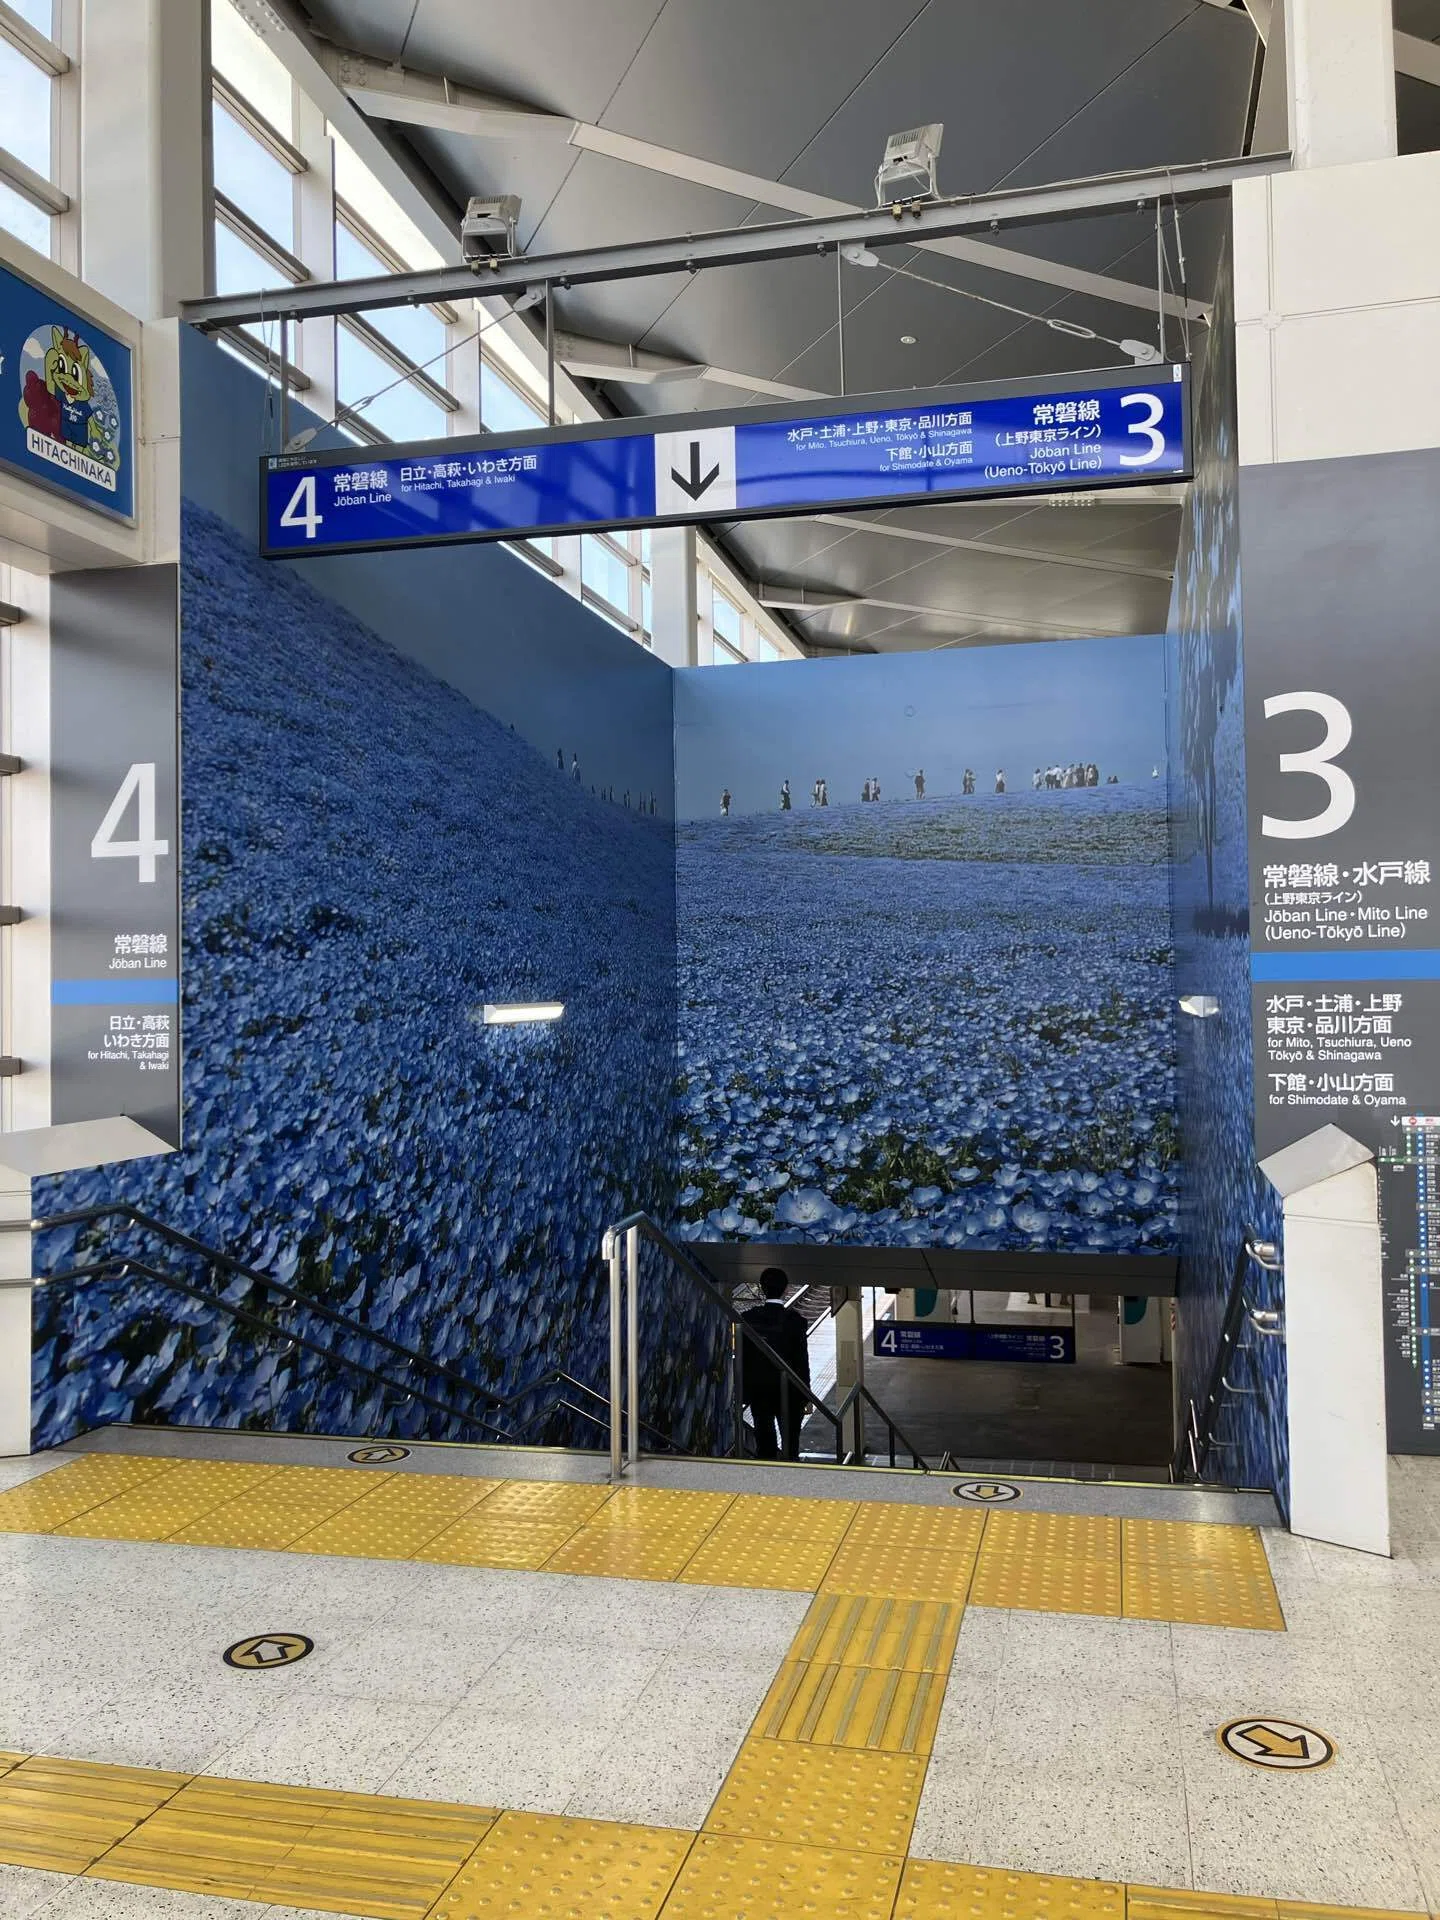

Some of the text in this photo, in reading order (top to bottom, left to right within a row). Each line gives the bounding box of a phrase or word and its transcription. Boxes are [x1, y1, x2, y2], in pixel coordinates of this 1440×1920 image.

[1032, 399, 1100, 426] 常磐線
[796, 443, 807, 451] for
[920, 431, 926, 439] &
[928, 428, 973, 439] Shinagawa
[1119, 393, 1166, 467] 3
[31, 433, 113, 487] HITACHINAKA
[884, 440, 973, 462] 下館・小山方面
[1030, 443, 1101, 460] Jōban Line
[400, 455, 537, 481] 日立・高萩・いわき方面
[879, 464, 890, 472] for
[892, 460, 935, 471] Shimodate
[944, 456, 973, 467] Oyama
[1069, 456, 1102, 471] Line)
[333, 469, 388, 493] 常磐線
[401, 474, 516, 492] for Hitachi, Takahagi & Iwaki
[280, 476, 323, 538] 4
[333, 492, 392, 507] Jōban Line
[1261, 691, 1356, 840] 3
[91, 762, 169, 883] 4
[1262, 860, 1432, 889] 常磐線・水戸線
[1264, 909, 1311, 923] Jōban
[1395, 905, 1428, 920] Line
[1265, 922, 1407, 941] (Ueno-Tōkyō Line)
[114, 933, 168, 955] 常磐線
[108, 957, 167, 969] Jōban Line
[1266, 993, 1403, 1014] 水戸・土浦・上野
[109, 1015, 170, 1031] 日立・高萩
[1266, 1015, 1393, 1035] 東京・品川方面
[103, 1032, 170, 1048] いわき方面
[1267, 1036, 1412, 1049] for Mito, Tsuchiura, Ueno
[88, 1050, 169, 1062] for Hitachi, Takahagi
[139, 1061, 169, 1070] & Iwaki
[1306, 1050, 1315, 1061] &
[1317, 1050, 1382, 1063] Shinagawa
[1268, 1072, 1395, 1092] 下館・小山方面
[1269, 1094, 1407, 1107] for Shimodate & Oyama
[880, 1330, 898, 1353] 4
[1049, 1335, 1065, 1359] 3
